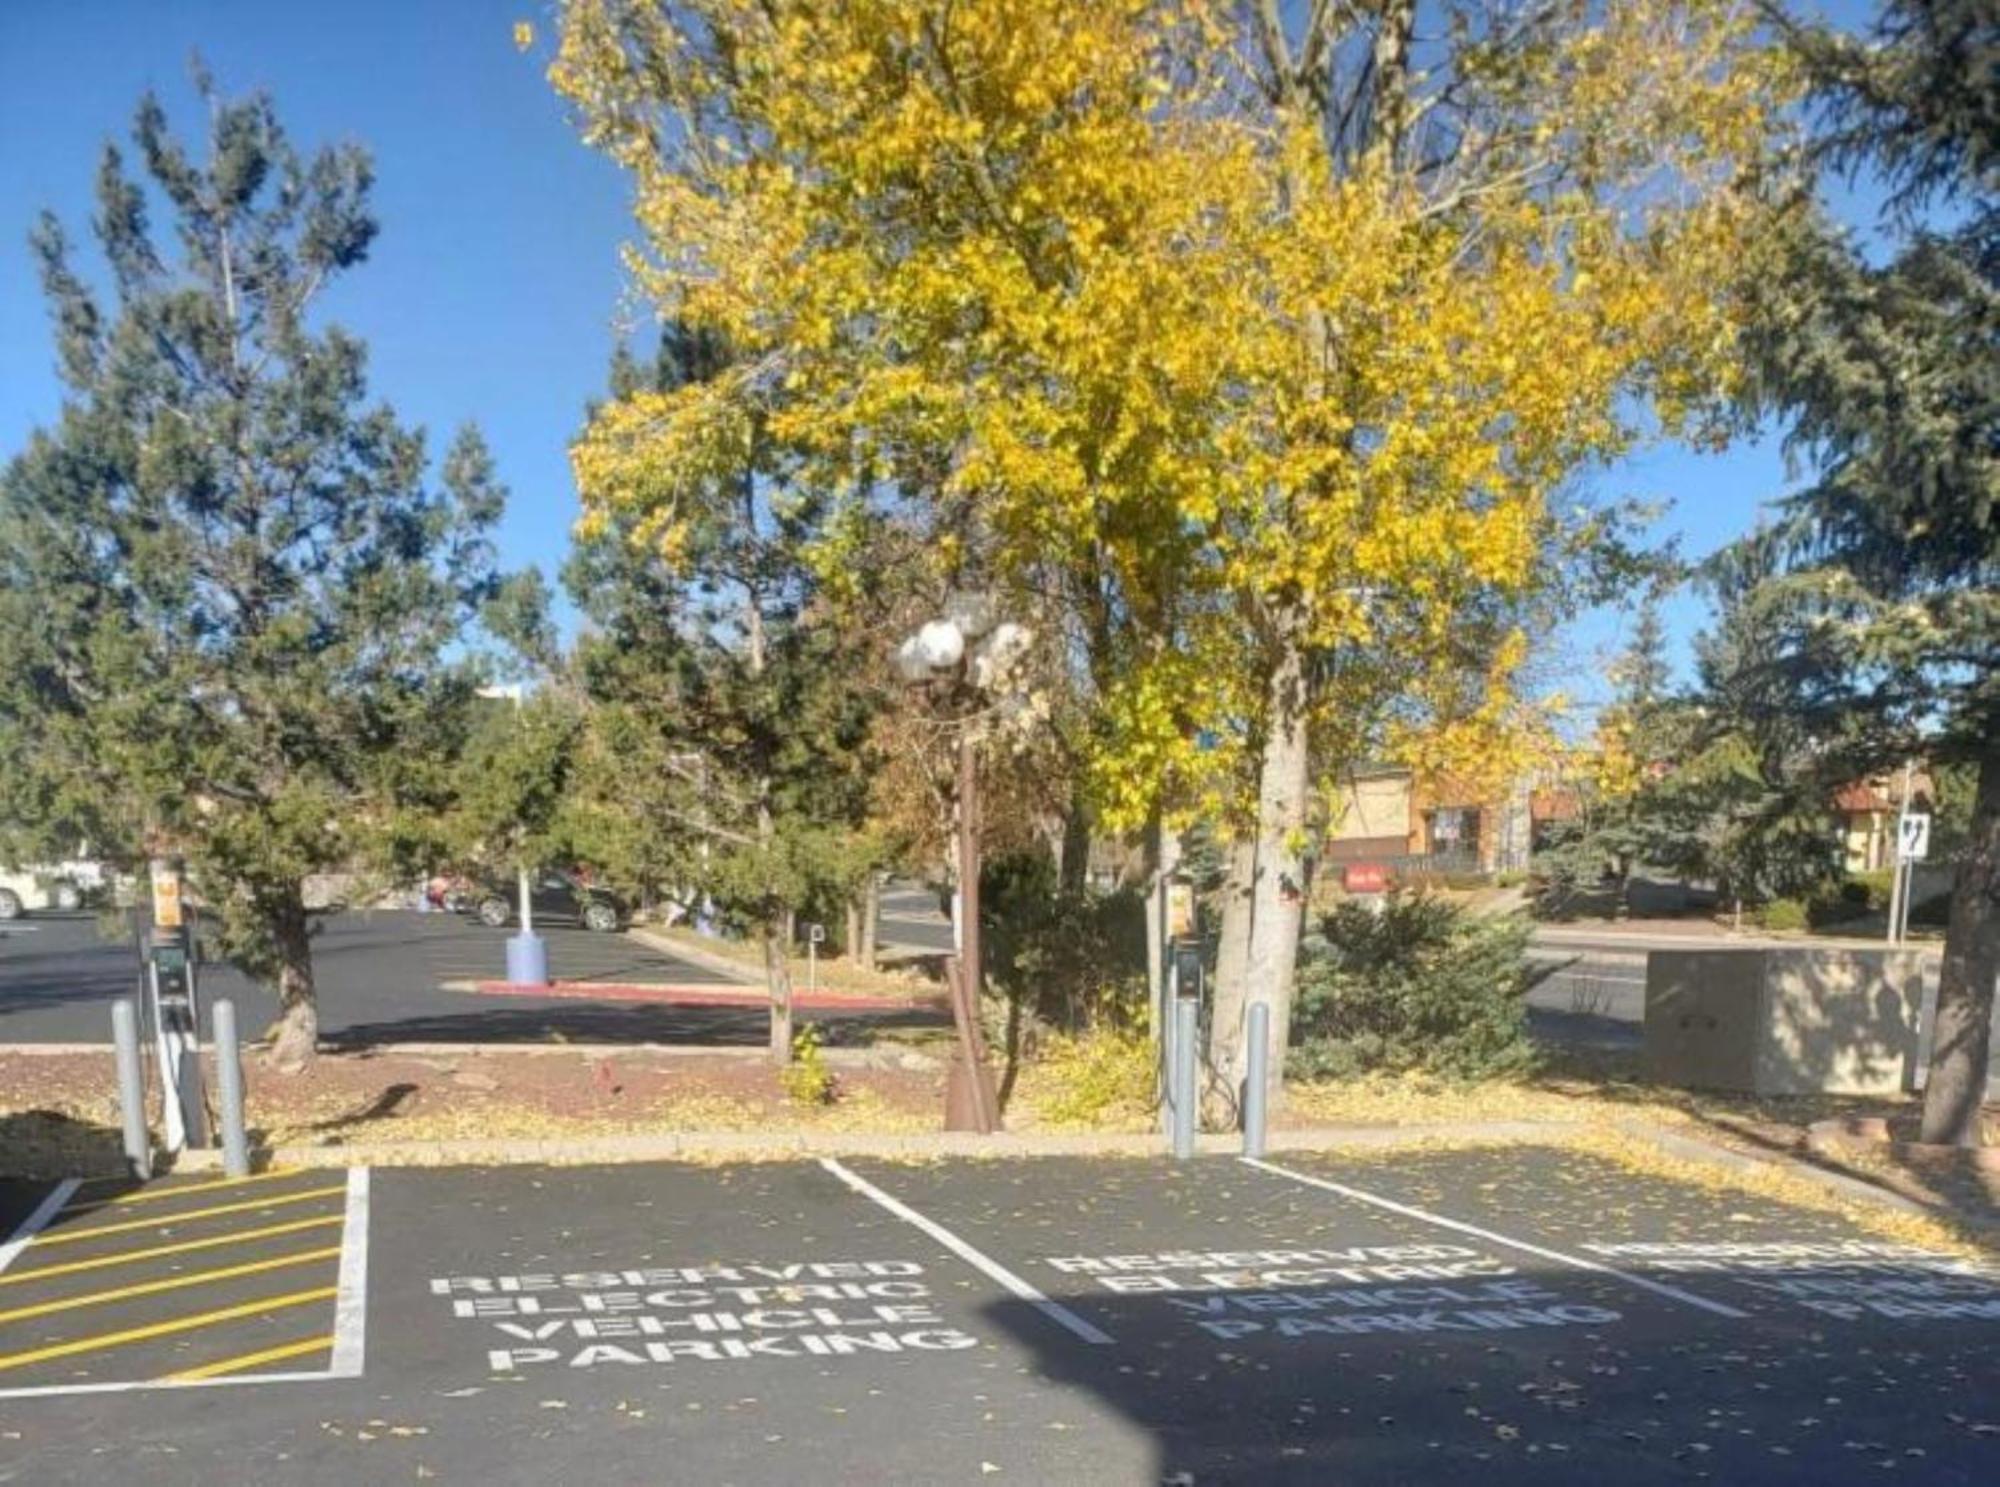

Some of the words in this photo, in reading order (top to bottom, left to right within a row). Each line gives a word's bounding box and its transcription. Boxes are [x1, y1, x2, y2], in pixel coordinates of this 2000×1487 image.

[1047, 1245, 1477, 1272] RESERVED
[430, 1260, 924, 1294] RESERVED
[1098, 1260, 1516, 1292] ELECTRIC
[454, 1281, 929, 1317] ELECTRIC
[1169, 1280, 1558, 1312] VEHICLE
[494, 1304, 944, 1340] VEHICLE
[1199, 1304, 1621, 1339] PARKING
[489, 1328, 978, 1370] PARKING
